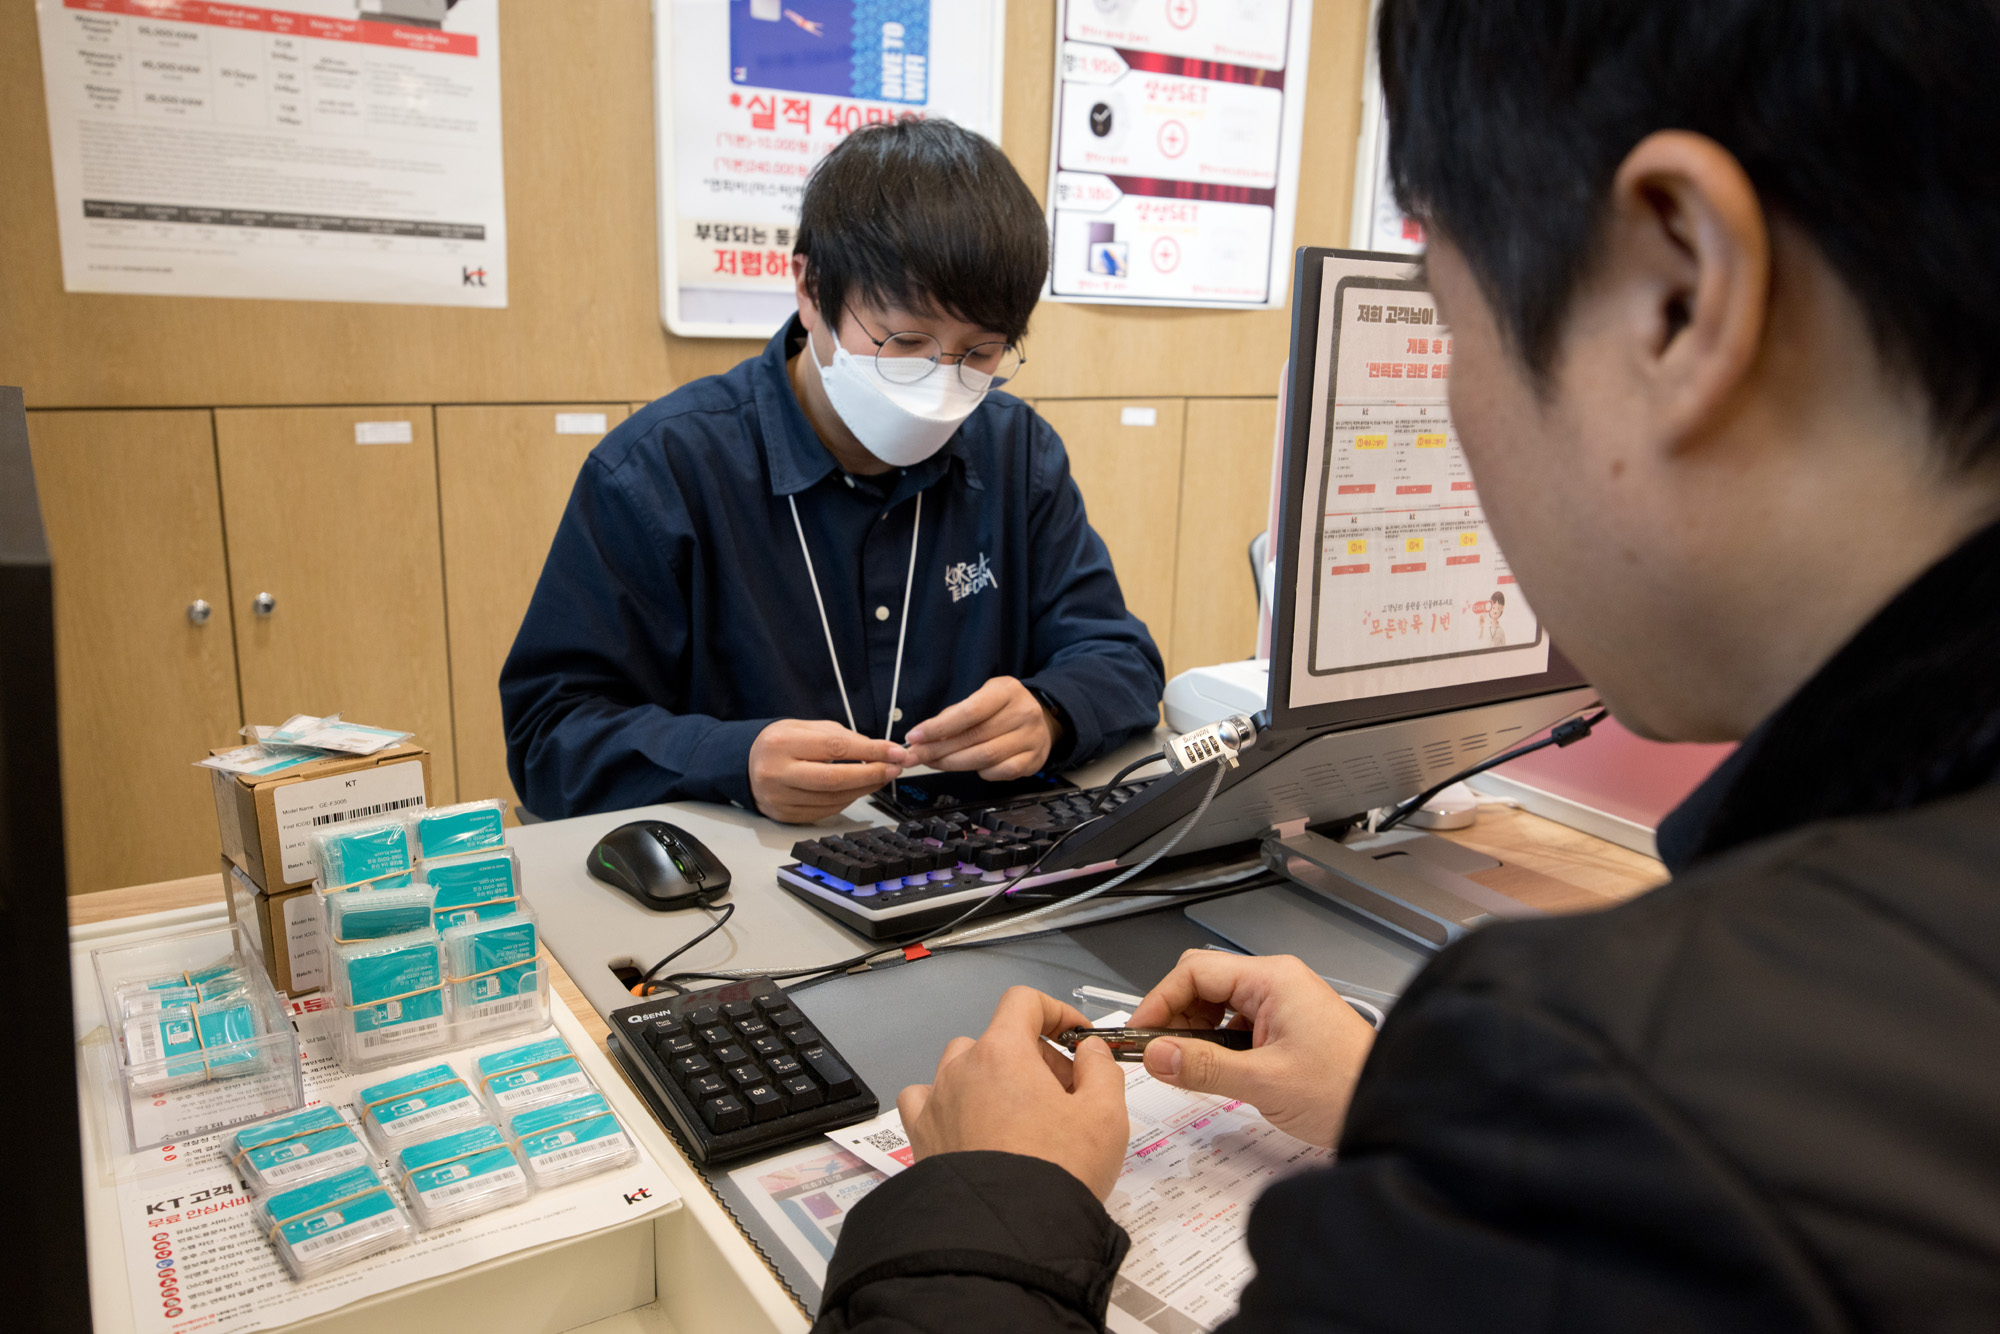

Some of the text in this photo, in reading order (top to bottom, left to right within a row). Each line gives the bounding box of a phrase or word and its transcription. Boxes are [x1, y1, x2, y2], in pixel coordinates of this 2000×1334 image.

[882, 21, 904, 48] TO
[695, 223, 767, 244] 부담되는
[463, 266, 487, 286] kt
[1357, 304, 1434, 325] 저희 고객님이
[1406, 338, 1443, 354] 개통 후
[1362, 408, 1369, 416] kt
[1420, 408, 1427, 416] kt
[1409, 513, 1416, 521] kt
[345, 779, 357, 788] KT
[282, 807, 298, 815] Model
[299, 804, 314, 812] Name
[286, 842, 297, 850] Last
[478, 986, 486, 994] kt
[675, 1042, 693, 1050] Home
[807, 1048, 823, 1056] Enter
[752, 1088, 766, 1096] 00
[160, 1113, 257, 1140] 소액 결제 피해
[146, 1184, 234, 1215] KT 고객
[623, 1188, 652, 1205] kt
[148, 1214, 182, 1228] 무료
